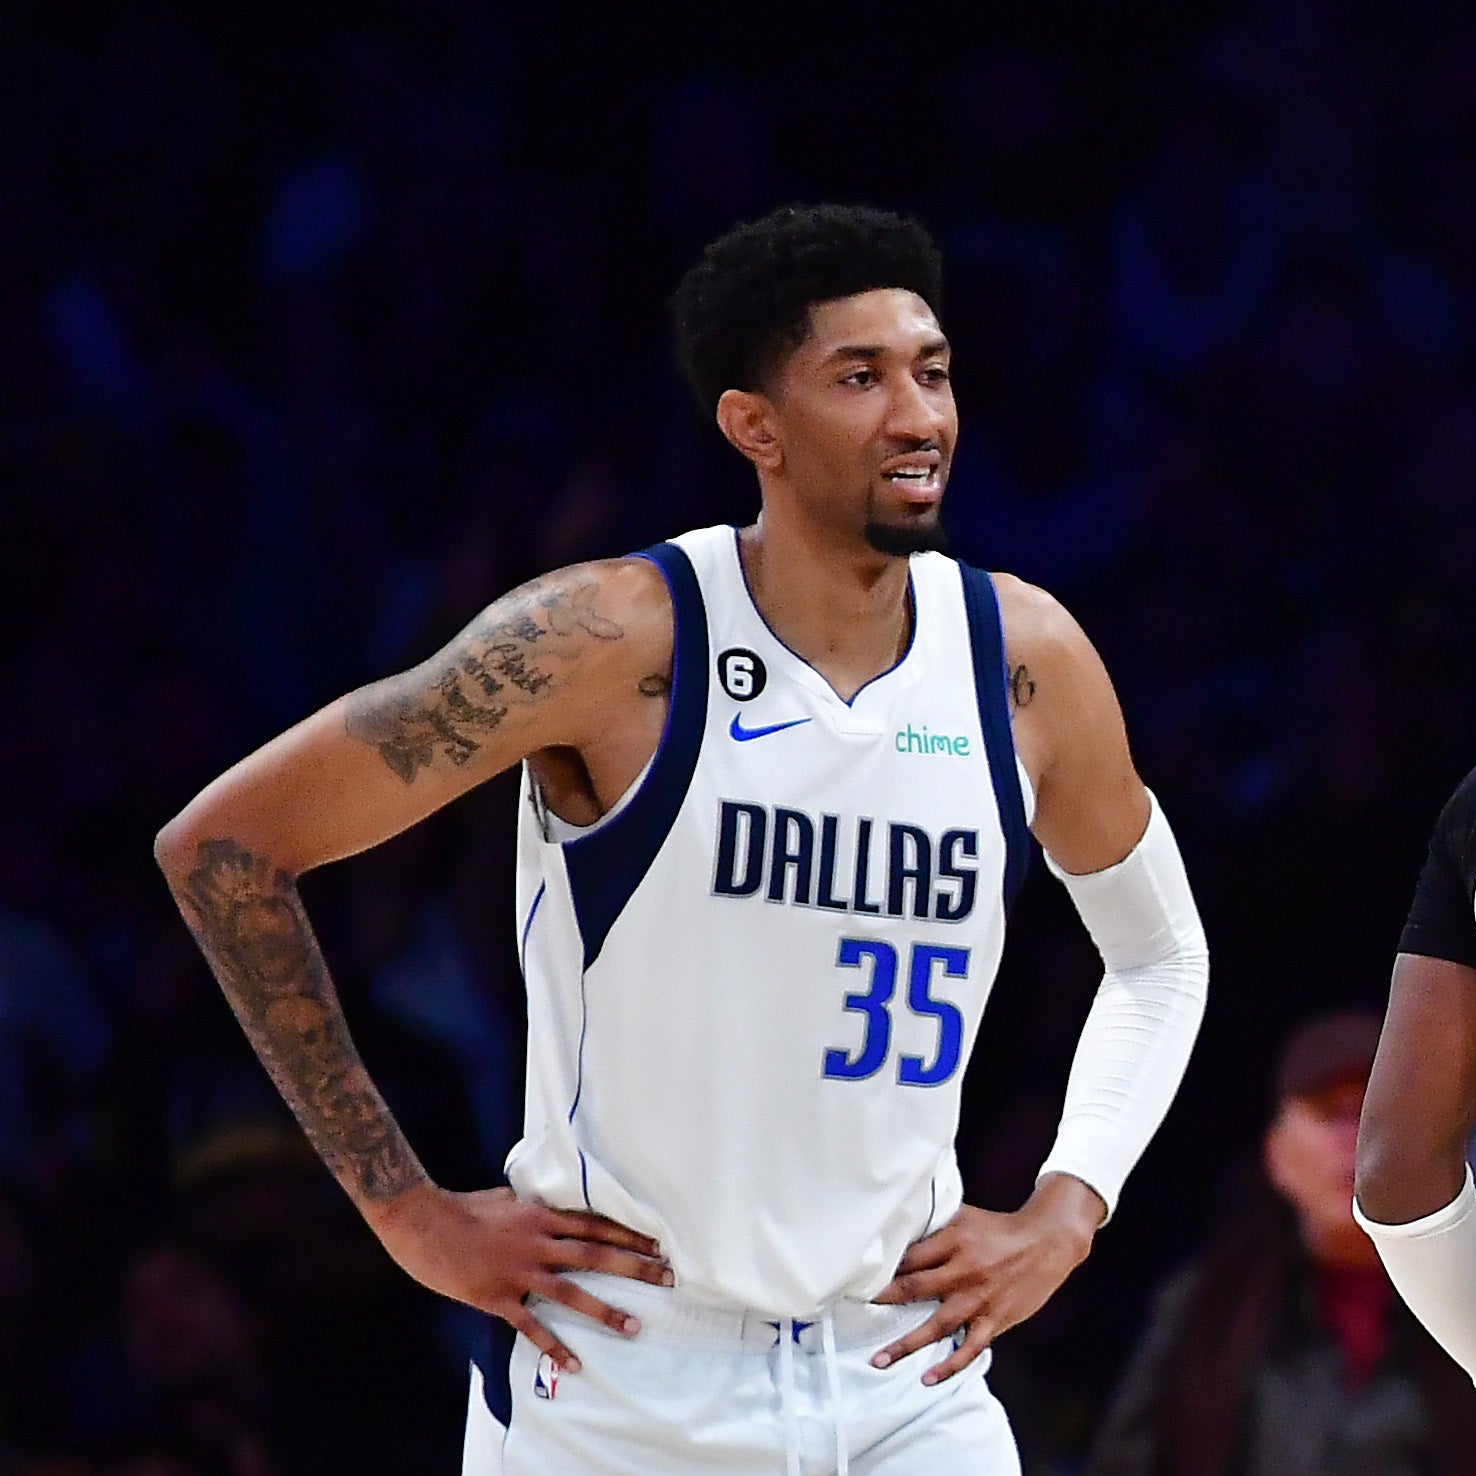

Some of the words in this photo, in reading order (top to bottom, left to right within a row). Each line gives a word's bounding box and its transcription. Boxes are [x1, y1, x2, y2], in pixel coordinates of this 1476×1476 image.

[725, 654, 755, 696] 6
[895, 724, 971, 757] chime
[710, 797, 980, 924] DALLAS
[821, 936, 972, 1088] 35
